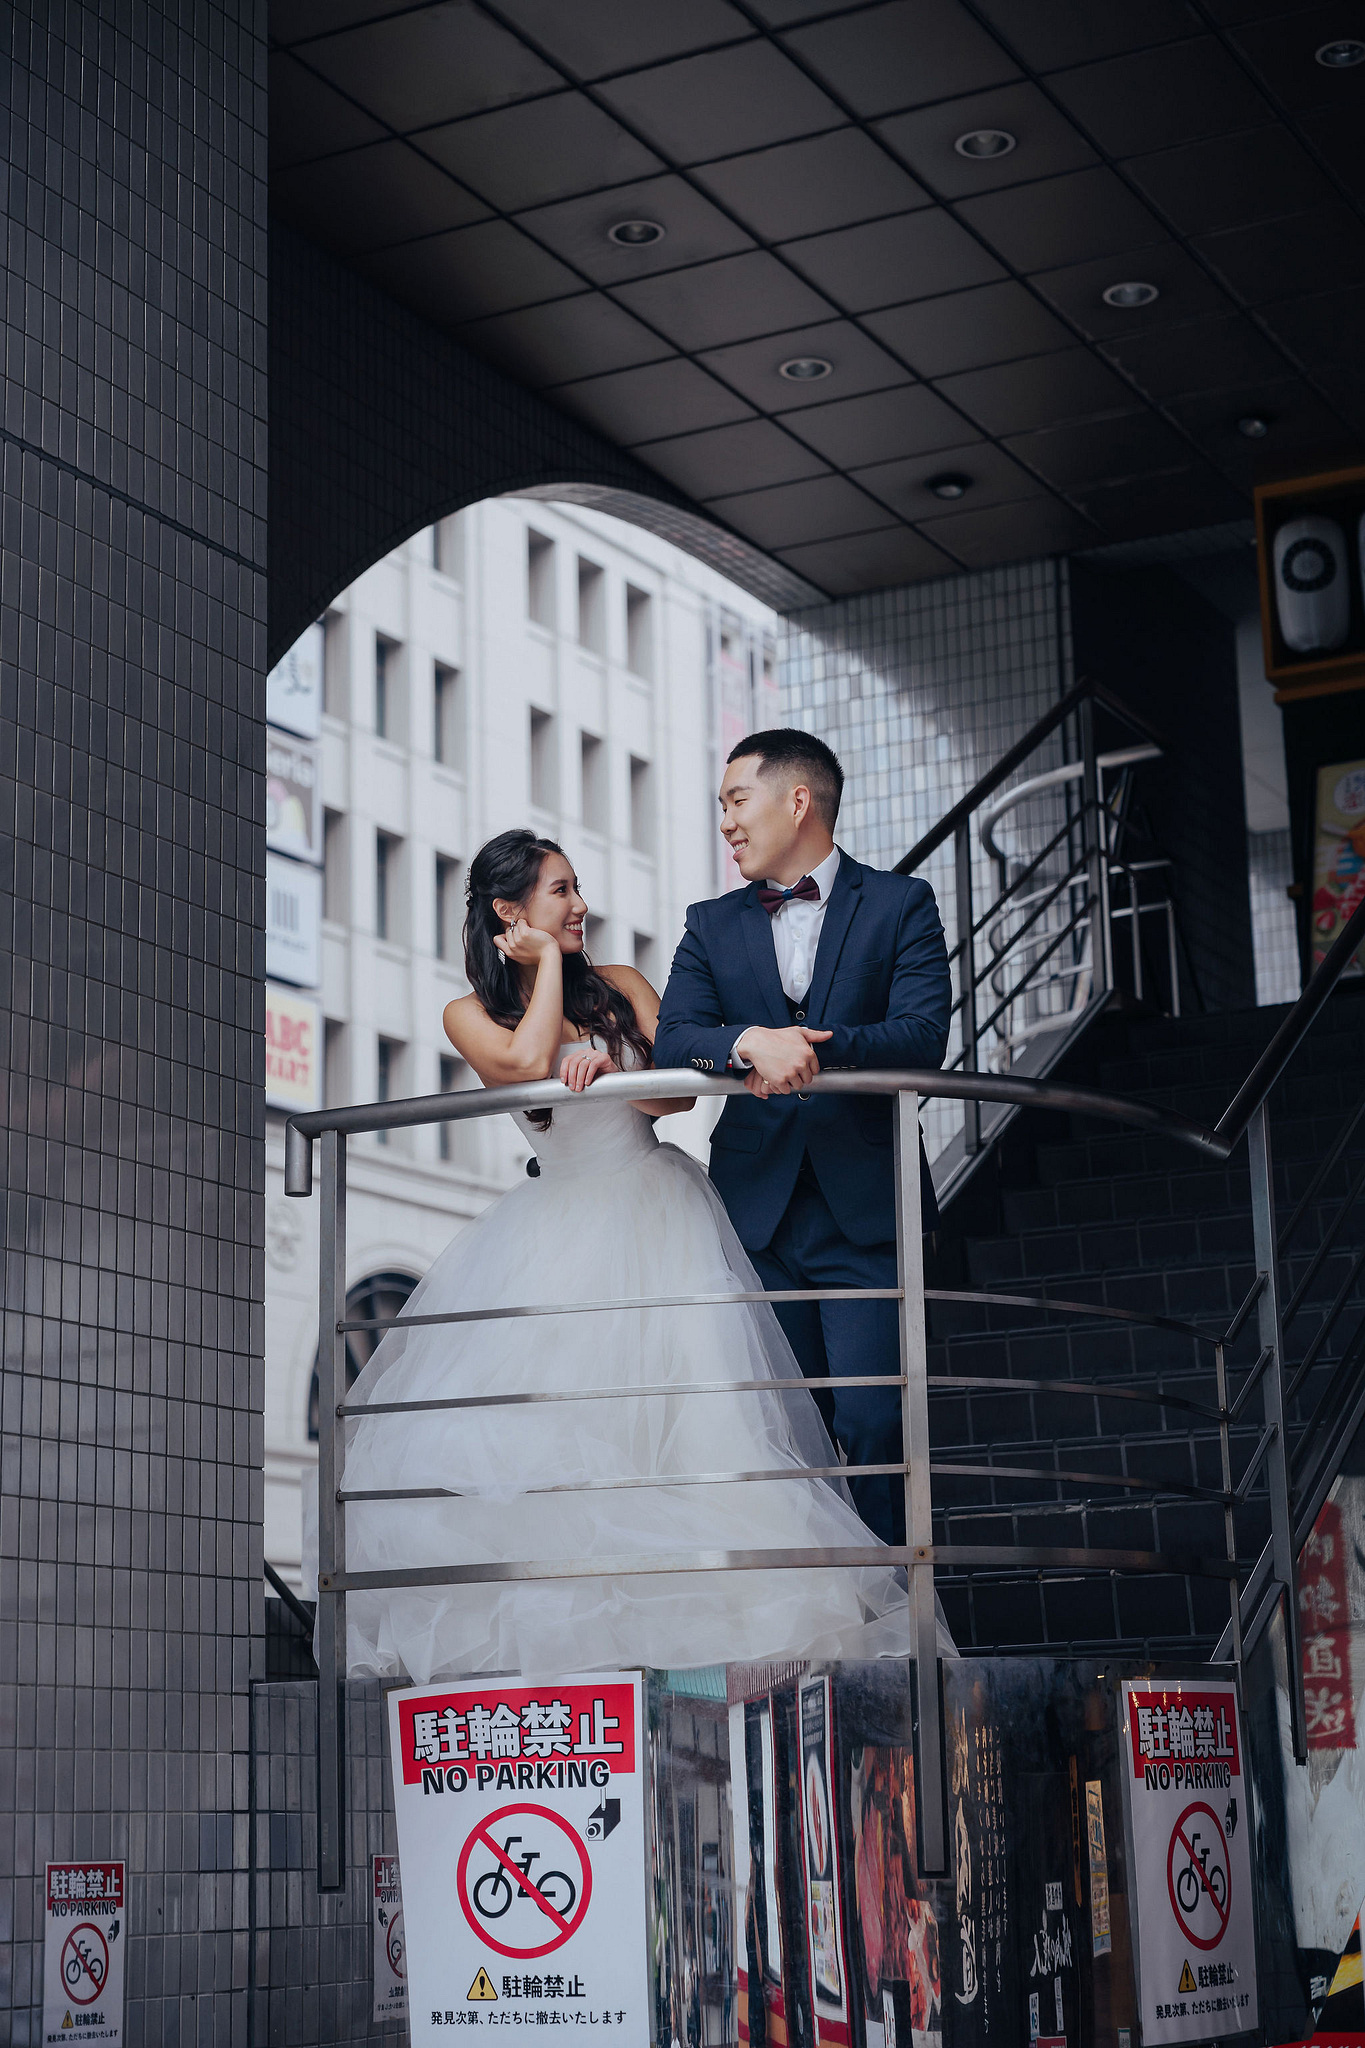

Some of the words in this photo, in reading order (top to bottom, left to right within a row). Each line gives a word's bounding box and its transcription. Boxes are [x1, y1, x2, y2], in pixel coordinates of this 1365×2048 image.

[413, 1698, 624, 1764] 駐輪禁止
[1137, 1704, 1235, 1760] 駐輪禁止
[422, 1766, 468, 1795] NO
[476, 1760, 610, 1791] PARKING
[1144, 1763, 1170, 1790] NO
[1174, 1762, 1231, 1790] PARKING
[50, 1868, 121, 1900] 駐輪禁止
[52, 1902, 68, 1917] NO
[70, 1900, 117, 1916] PARKING
[502, 1974, 586, 1998] 駐輪禁止
[1198, 1962, 1234, 1988] 駐輪禁止
[75, 2012, 105, 2026] 駐輪禁止
[431, 2010, 627, 2025] 発見次第、ただちに撤去いたします
